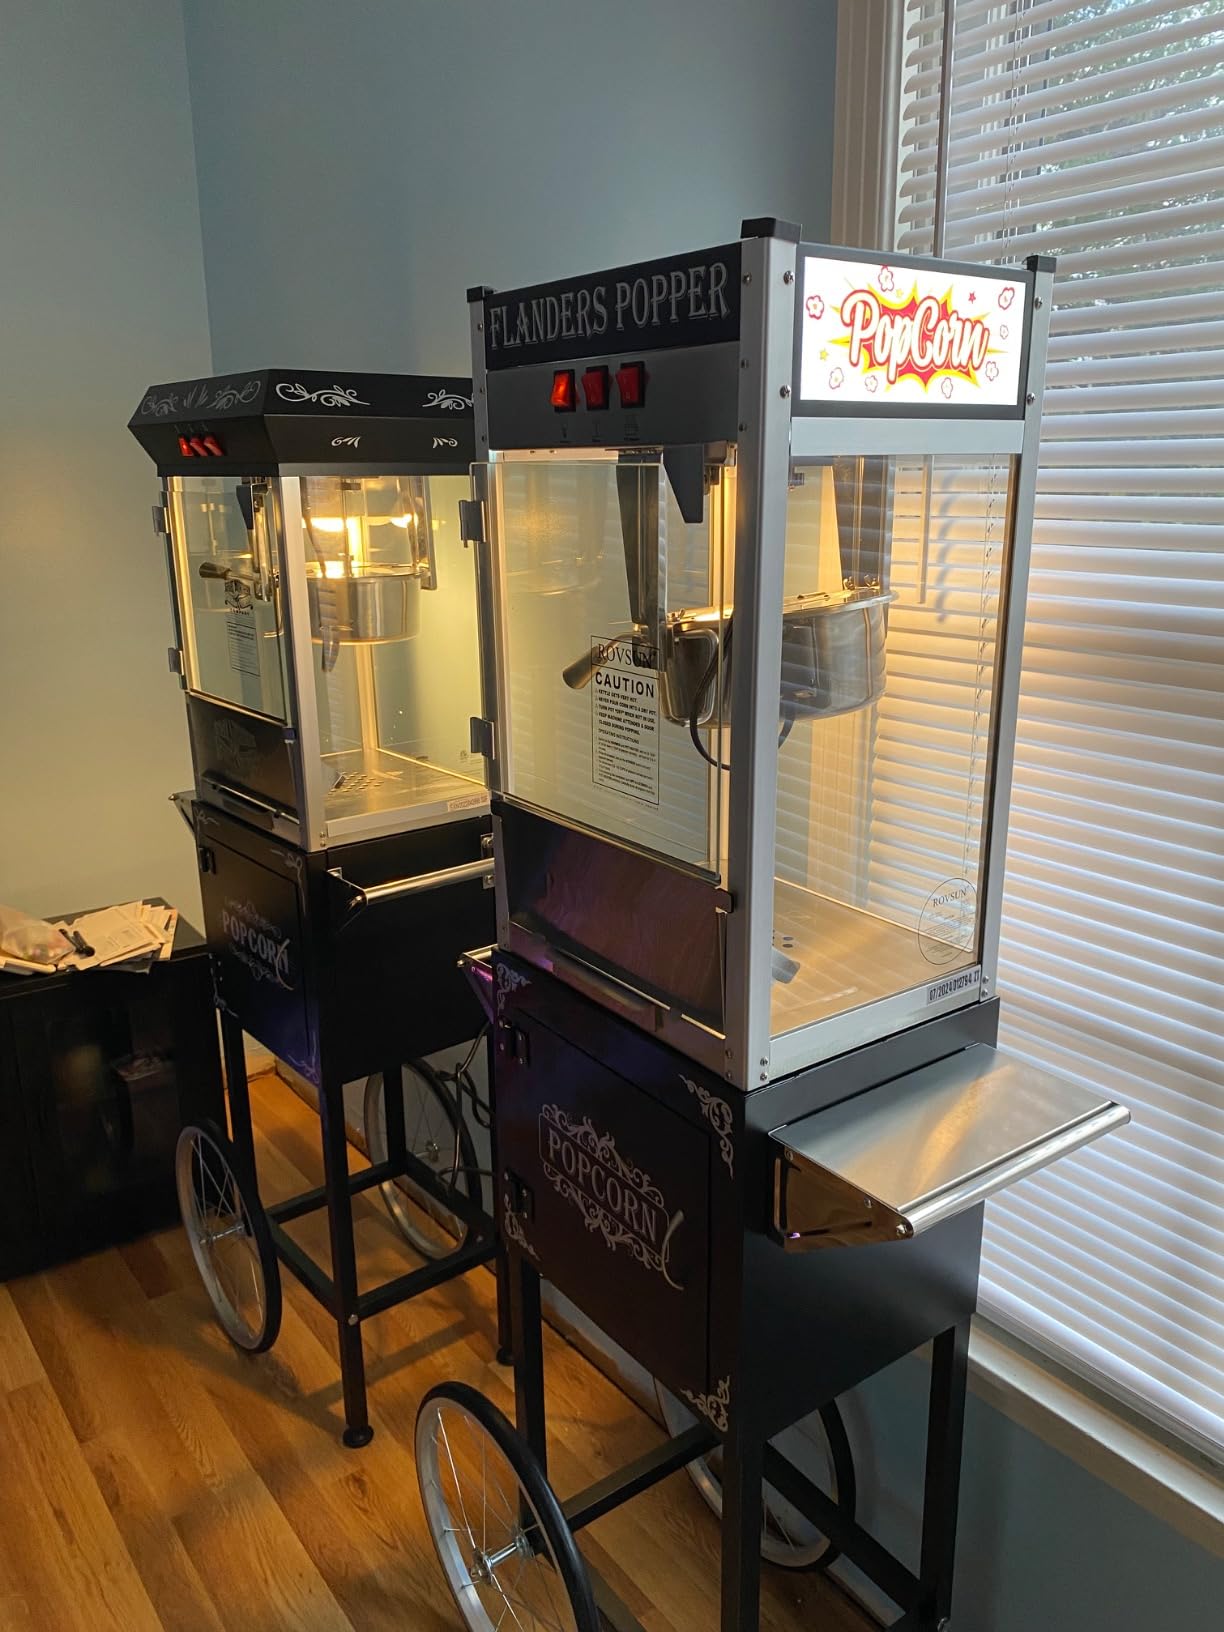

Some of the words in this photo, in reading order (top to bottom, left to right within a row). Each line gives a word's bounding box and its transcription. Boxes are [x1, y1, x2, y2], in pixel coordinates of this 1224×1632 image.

[489, 284, 609, 350] FLANDERS
[615, 261, 731, 325] POPPER
[841, 289, 991, 385] PopCorn
[595, 671, 655, 698] CAUTION
[933, 888, 966, 908] ROVSUN
[222, 909, 289, 975] POPCORN
[546, 1126, 659, 1243] POPCORN
